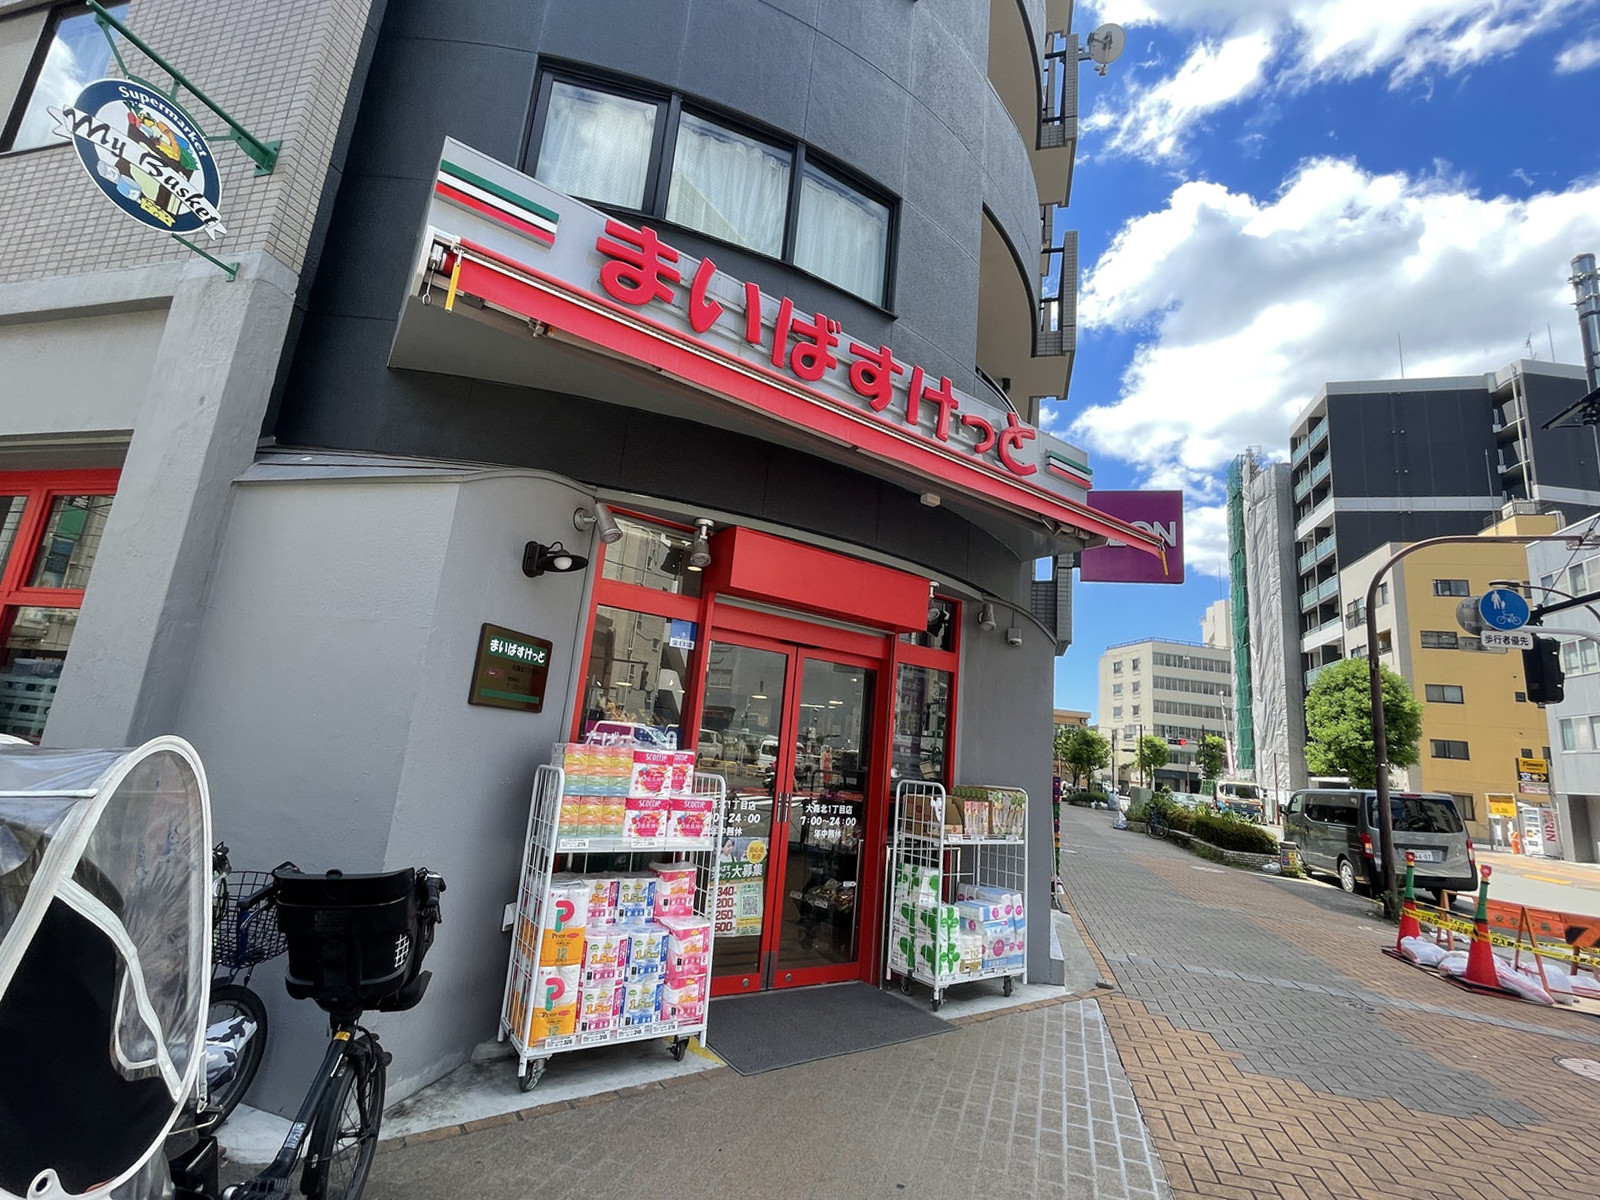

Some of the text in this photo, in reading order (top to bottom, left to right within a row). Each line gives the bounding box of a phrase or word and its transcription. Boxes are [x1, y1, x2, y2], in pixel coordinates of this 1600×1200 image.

[118, 86, 207, 158] Supermarket
[63, 108, 220, 226] My Basket
[596, 219, 1037, 476] まいばすけっと
[490, 639, 545, 663] まいばすけっと
[1485, 634, 1529, 646] 歩行者優先
[805, 804, 853, 815] 大森北1丁目店
[731, 863, 763, 879] 大募集
